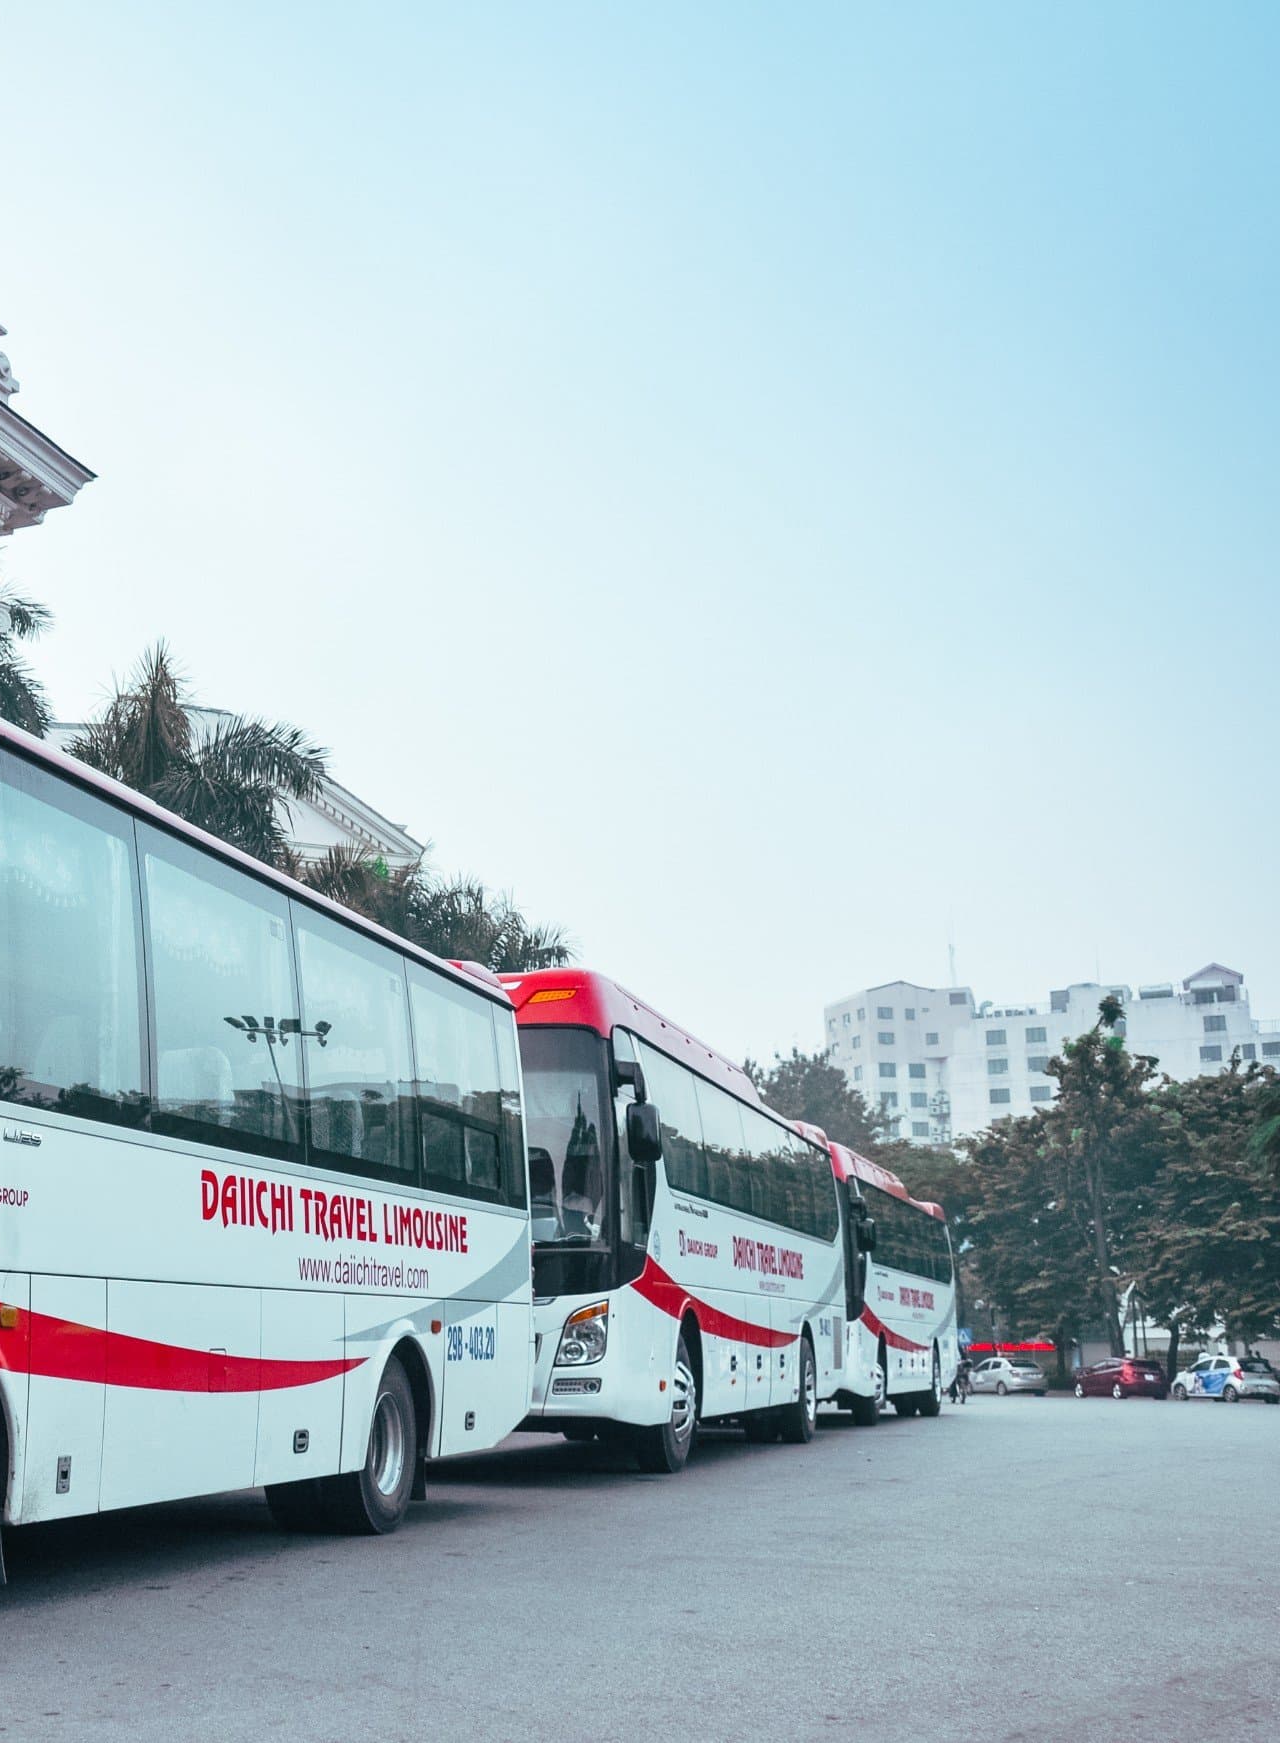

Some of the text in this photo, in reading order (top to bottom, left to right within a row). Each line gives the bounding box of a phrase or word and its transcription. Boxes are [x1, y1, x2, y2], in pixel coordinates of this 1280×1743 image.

[201, 1169, 469, 1254] DAIICHI TRAVEL LIMOUSINE
[298, 1253, 430, 1290] www.daiichitravel.com
